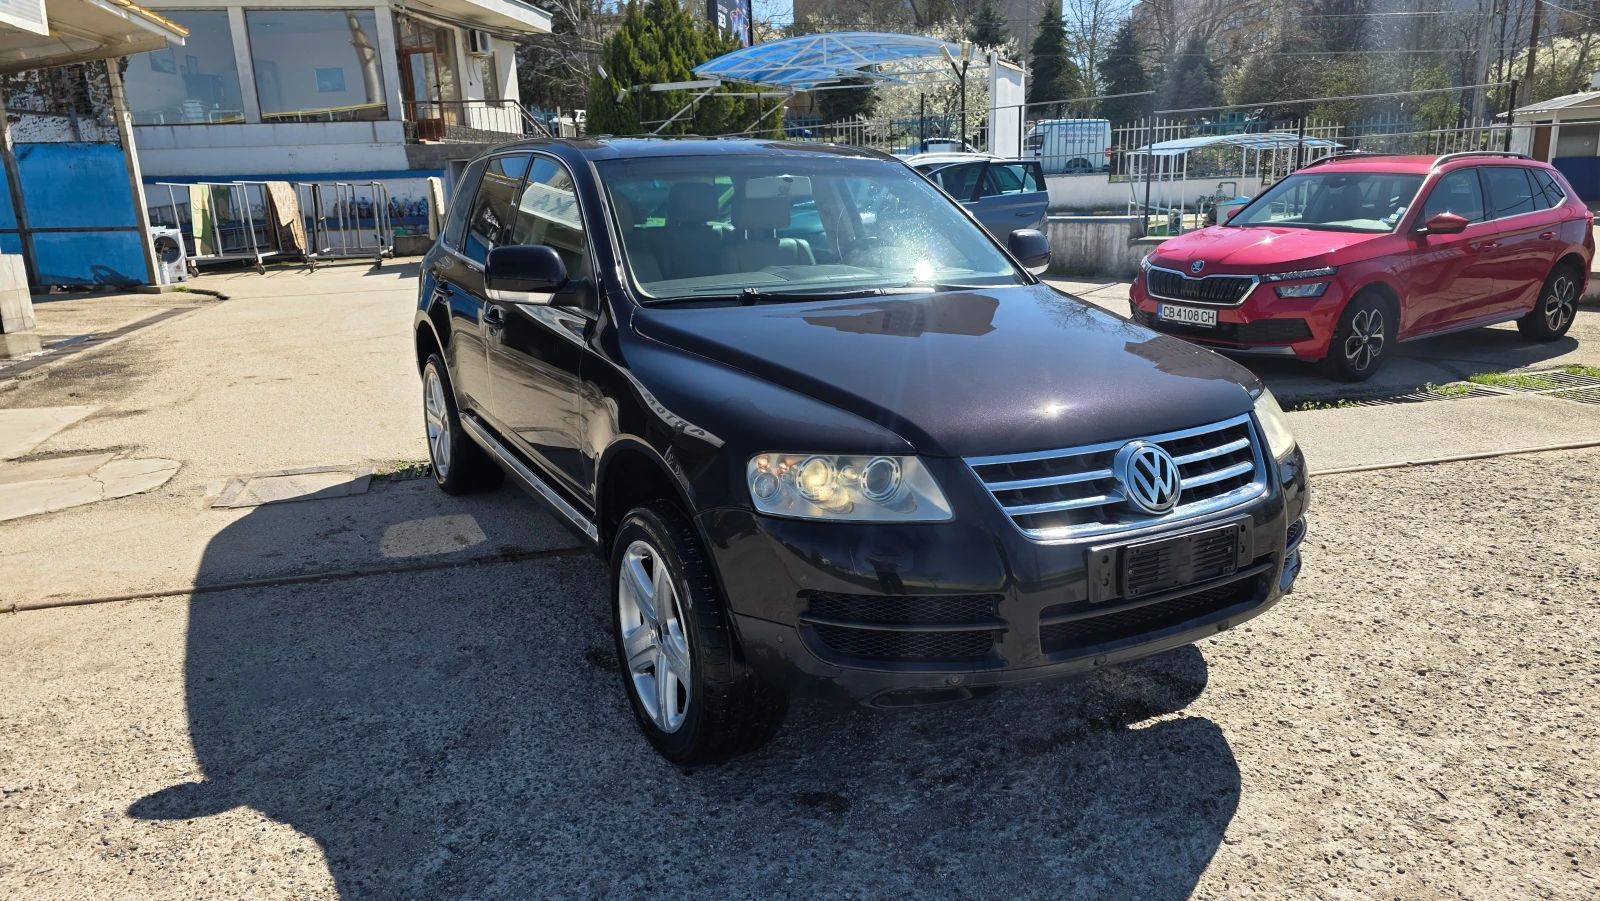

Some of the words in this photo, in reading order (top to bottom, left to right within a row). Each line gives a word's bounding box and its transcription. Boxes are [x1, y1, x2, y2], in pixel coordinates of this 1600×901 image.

[1163, 306, 1175, 318] CB
[1176, 308, 1199, 321] 4108
[1201, 311, 1215, 324] CH
[1127, 446, 1178, 511] VW
